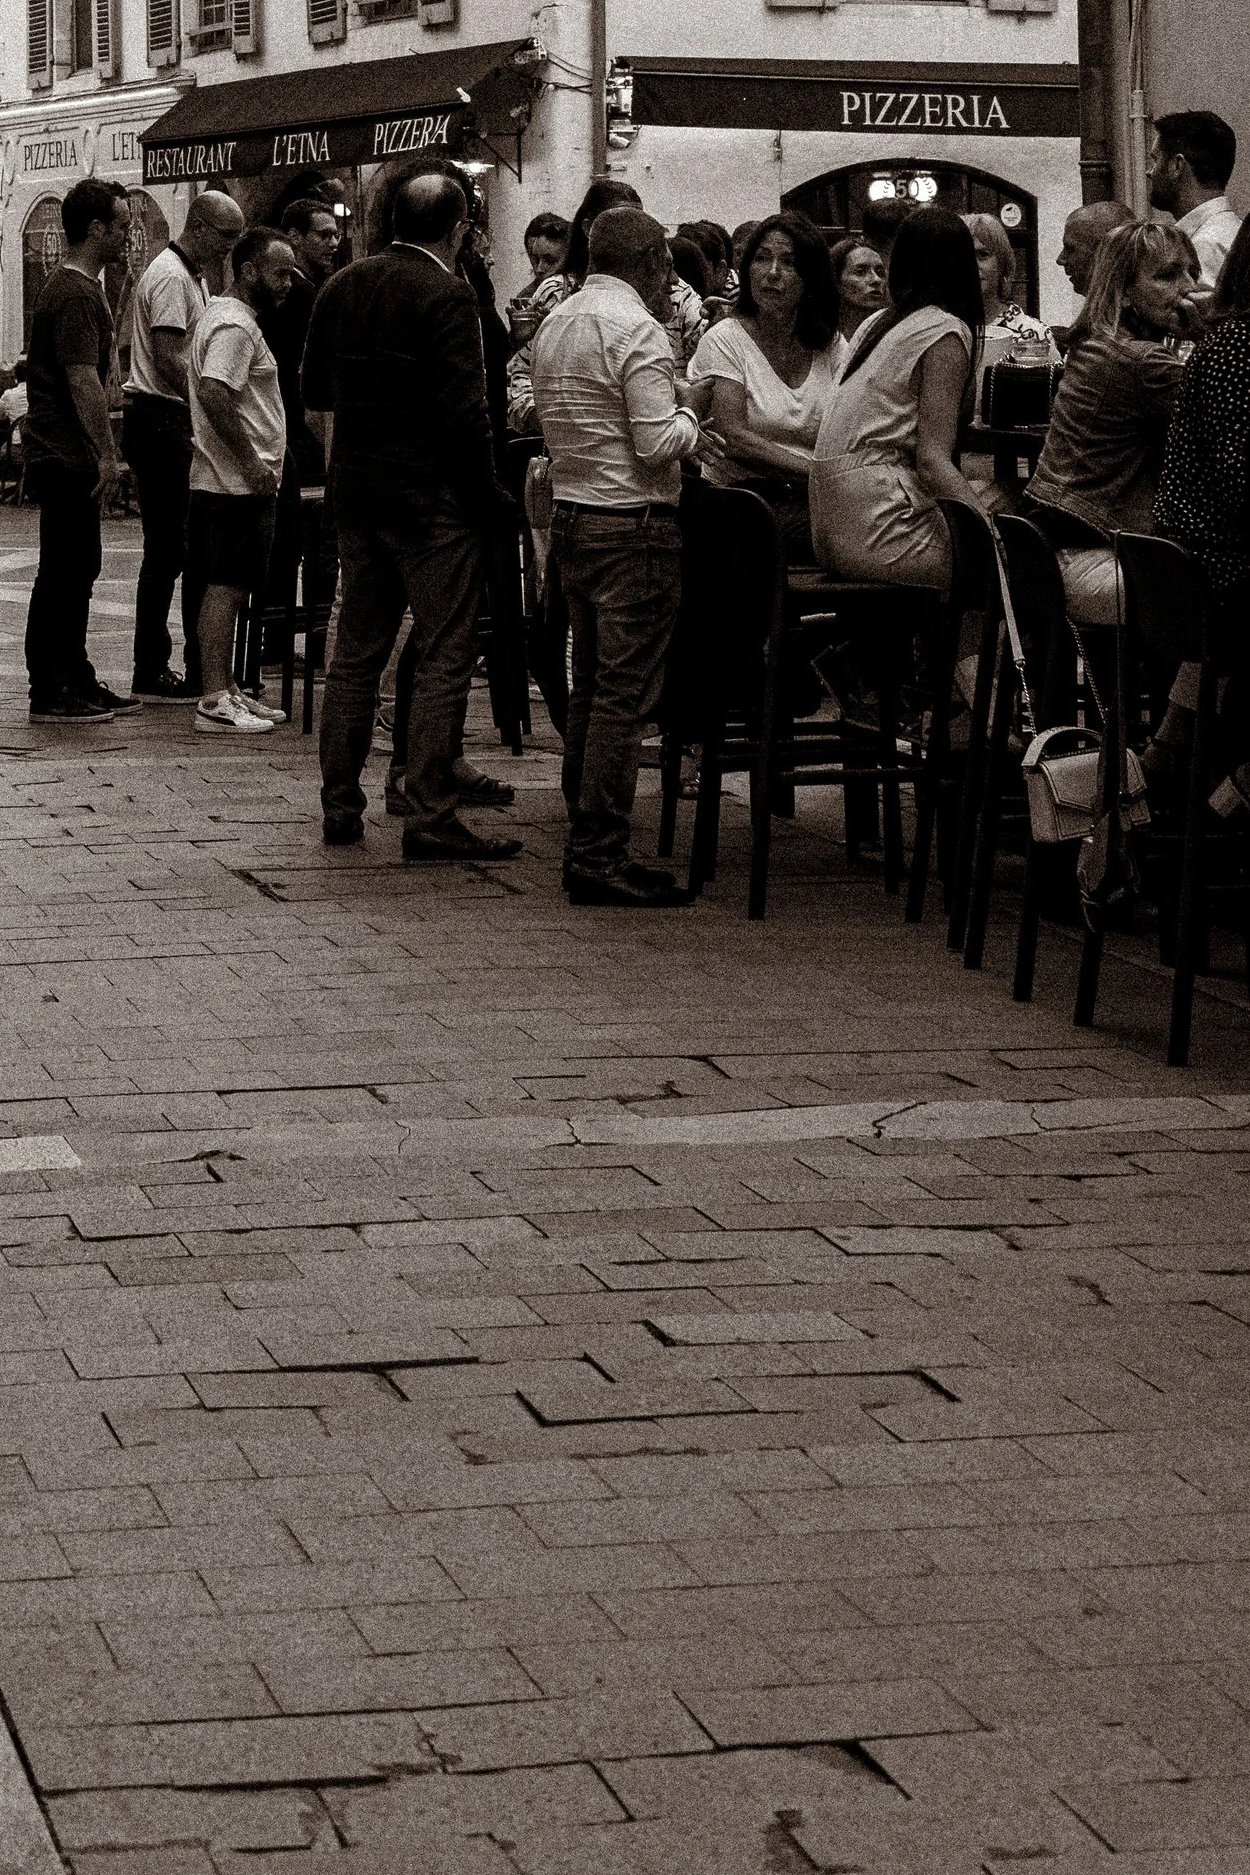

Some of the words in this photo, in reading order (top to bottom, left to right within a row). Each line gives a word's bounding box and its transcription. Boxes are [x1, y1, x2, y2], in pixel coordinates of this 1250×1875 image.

[840, 91, 1010, 129] PIZZERIA
[23, 139, 78, 171] PIZZERIA
[146, 141, 237, 178] RESTAURANT
[372, 113, 452, 156] PIZZERIA
[895, 179, 920, 199] 50
